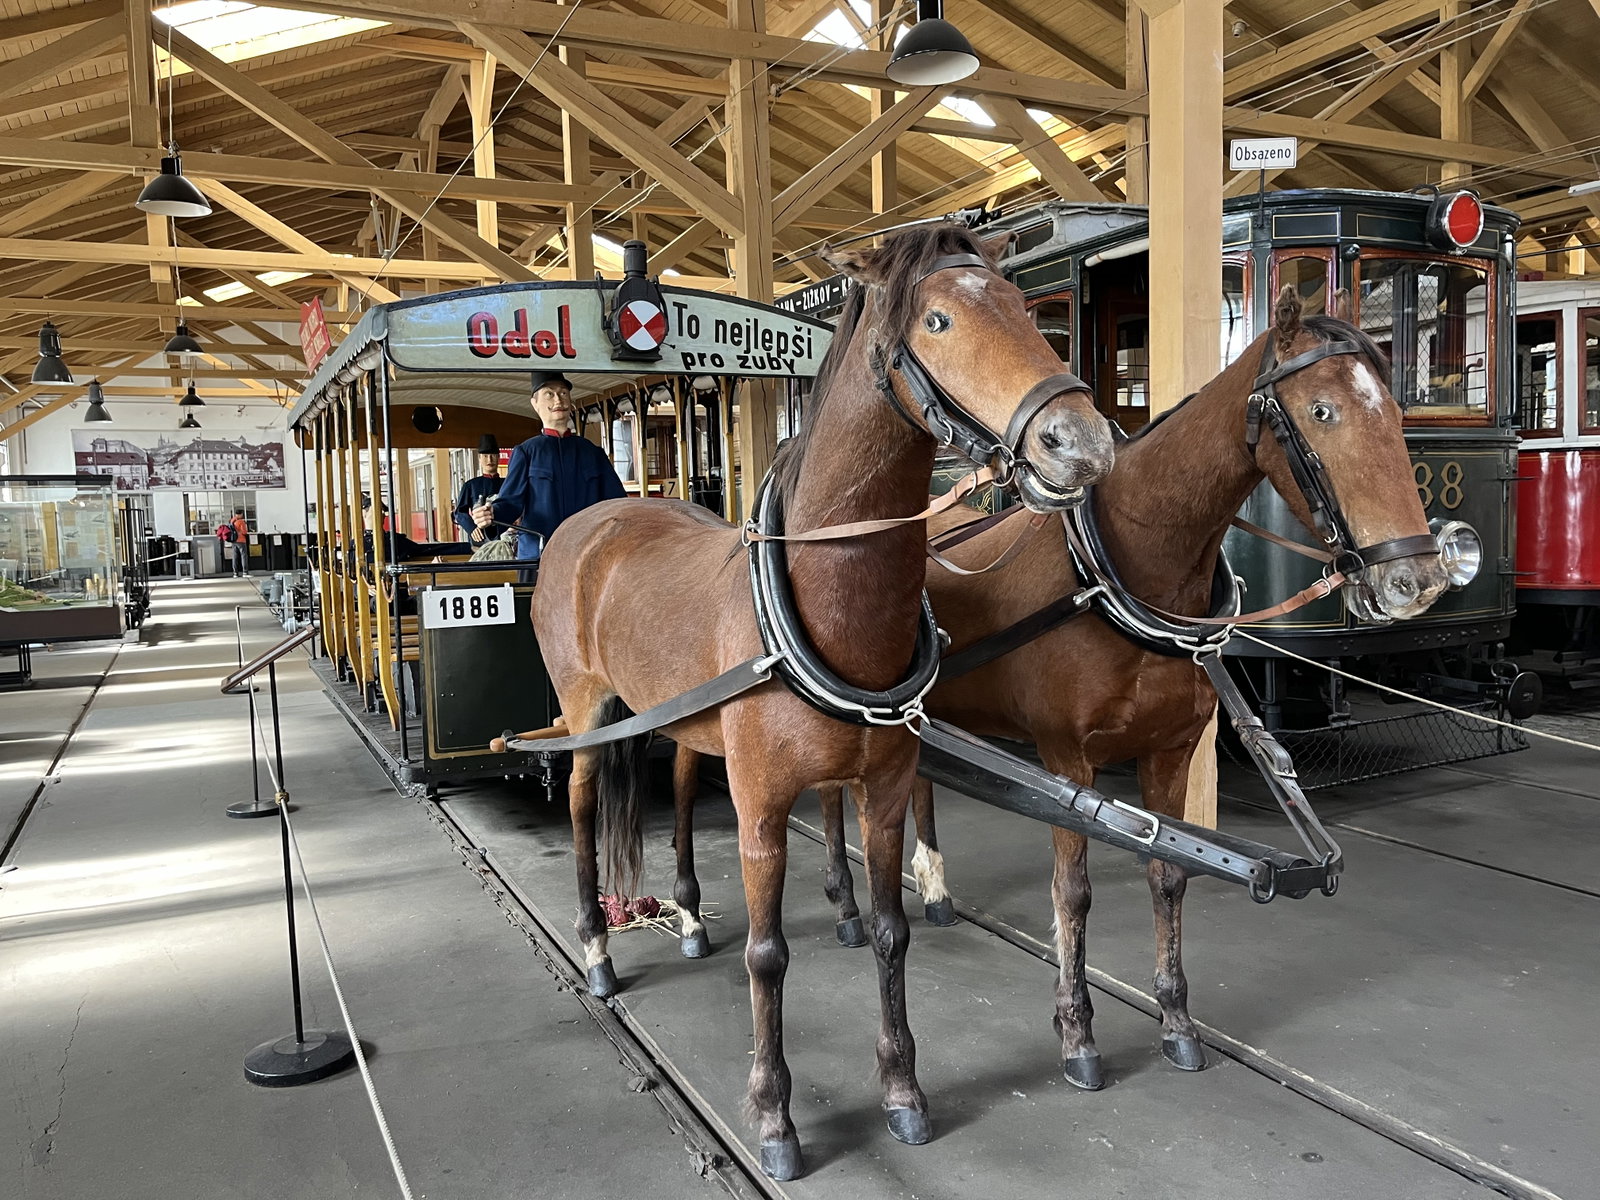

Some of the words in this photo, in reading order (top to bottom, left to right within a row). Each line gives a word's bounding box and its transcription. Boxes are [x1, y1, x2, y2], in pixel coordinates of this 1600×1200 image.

[1235, 146, 1291, 161] Obsazeno
[467, 304, 577, 359] Odol
[672, 301, 700, 339] To
[681, 352, 725, 371] pro
[736, 352, 796, 375] zuby
[668, 481, 676, 496] 7
[439, 595, 499, 620] 1886
